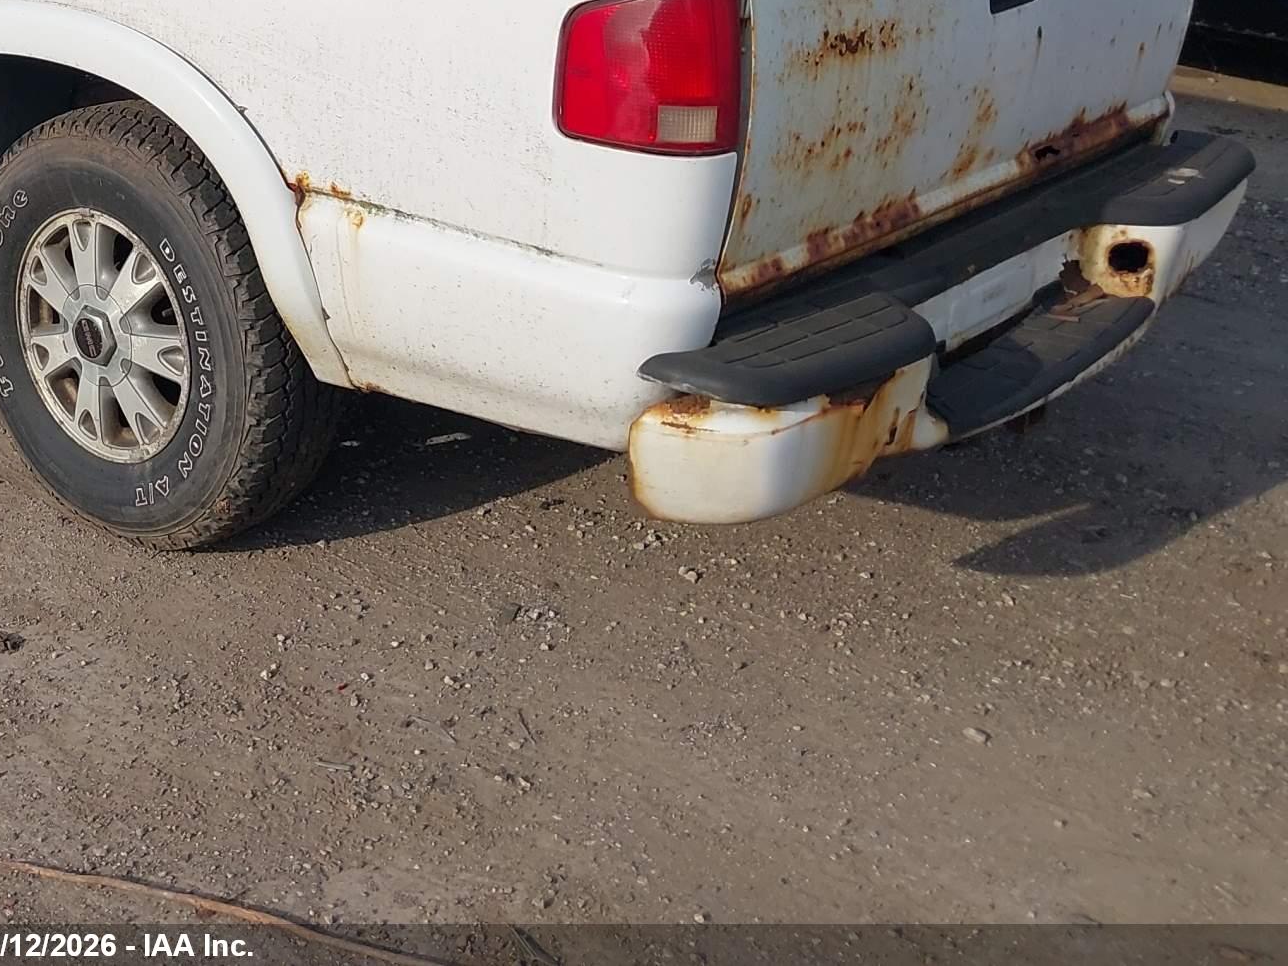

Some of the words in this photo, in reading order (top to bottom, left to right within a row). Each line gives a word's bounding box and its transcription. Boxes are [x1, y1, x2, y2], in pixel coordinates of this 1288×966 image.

[81, 319, 98, 357] GMC
[159, 238, 213, 480] DESTINATION
[135, 474, 171, 507] A/T
